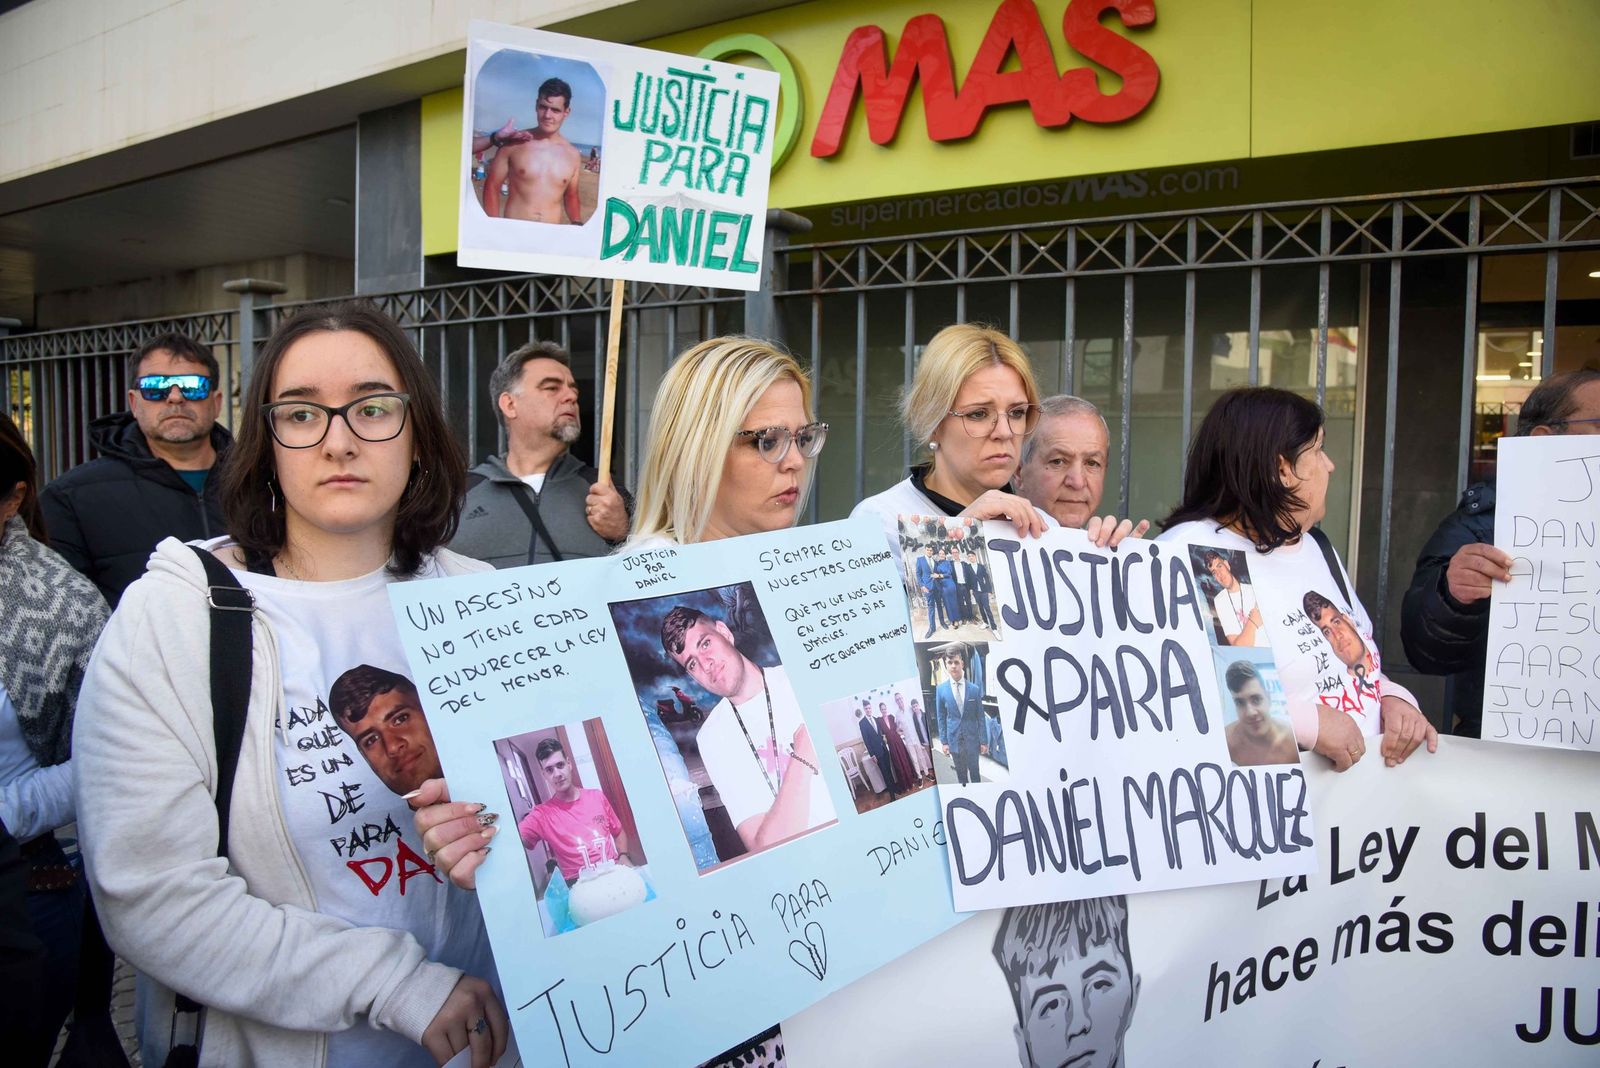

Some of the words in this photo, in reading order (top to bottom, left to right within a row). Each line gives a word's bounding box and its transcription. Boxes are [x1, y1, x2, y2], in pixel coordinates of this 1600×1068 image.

[810, 0, 1161, 159] MAS
[613, 64, 770, 154] JUSTICIA
[639, 139, 751, 197] PARA
[831, 166, 1239, 230] supermercadosMAS.com
[600, 196, 760, 274] DANIEL
[1555, 455, 1600, 503] J
[622, 549, 677, 571] JUSTICIA
[645, 561, 666, 575] POR
[759, 543, 826, 571] SIEMPRE
[831, 538, 853, 553] EN
[768, 561, 846, 592] NUESTROS
[405, 602, 445, 632] UN
[455, 575, 562, 621] ASESINO
[635, 572, 677, 590] DANIEL
[847, 587, 868, 601] NOS
[987, 538, 1206, 638] JUSTICIA
[420, 639, 456, 664] NO
[463, 619, 524, 650] TIENE
[534, 607, 588, 629] EDAD
[797, 625, 814, 637] EN
[820, 608, 858, 628] ESTOS
[1297, 642, 1312, 654] ES
[1312, 636, 1324, 648] UN
[428, 646, 551, 696] ENDURECER
[554, 638, 576, 654] LA
[579, 627, 607, 647] LEY
[821, 653, 838, 667] TE
[1313, 651, 1330, 675] DE
[439, 691, 487, 714] DEL
[1043, 638, 1210, 742] PARA
[297, 724, 344, 752] QUE
[285, 764, 316, 787] ES
[321, 752, 354, 775] UN
[317, 781, 366, 824] DE
[946, 767, 1128, 886] DANIEL
[1122, 762, 1313, 882] MARQUEZ
[329, 813, 402, 858] PARA
[1330, 825, 1421, 885] Ley
[1445, 812, 1550, 871] del
[771, 878, 833, 934] PARA
[1204, 935, 1319, 1023] hace
[1331, 896, 1455, 966] más
